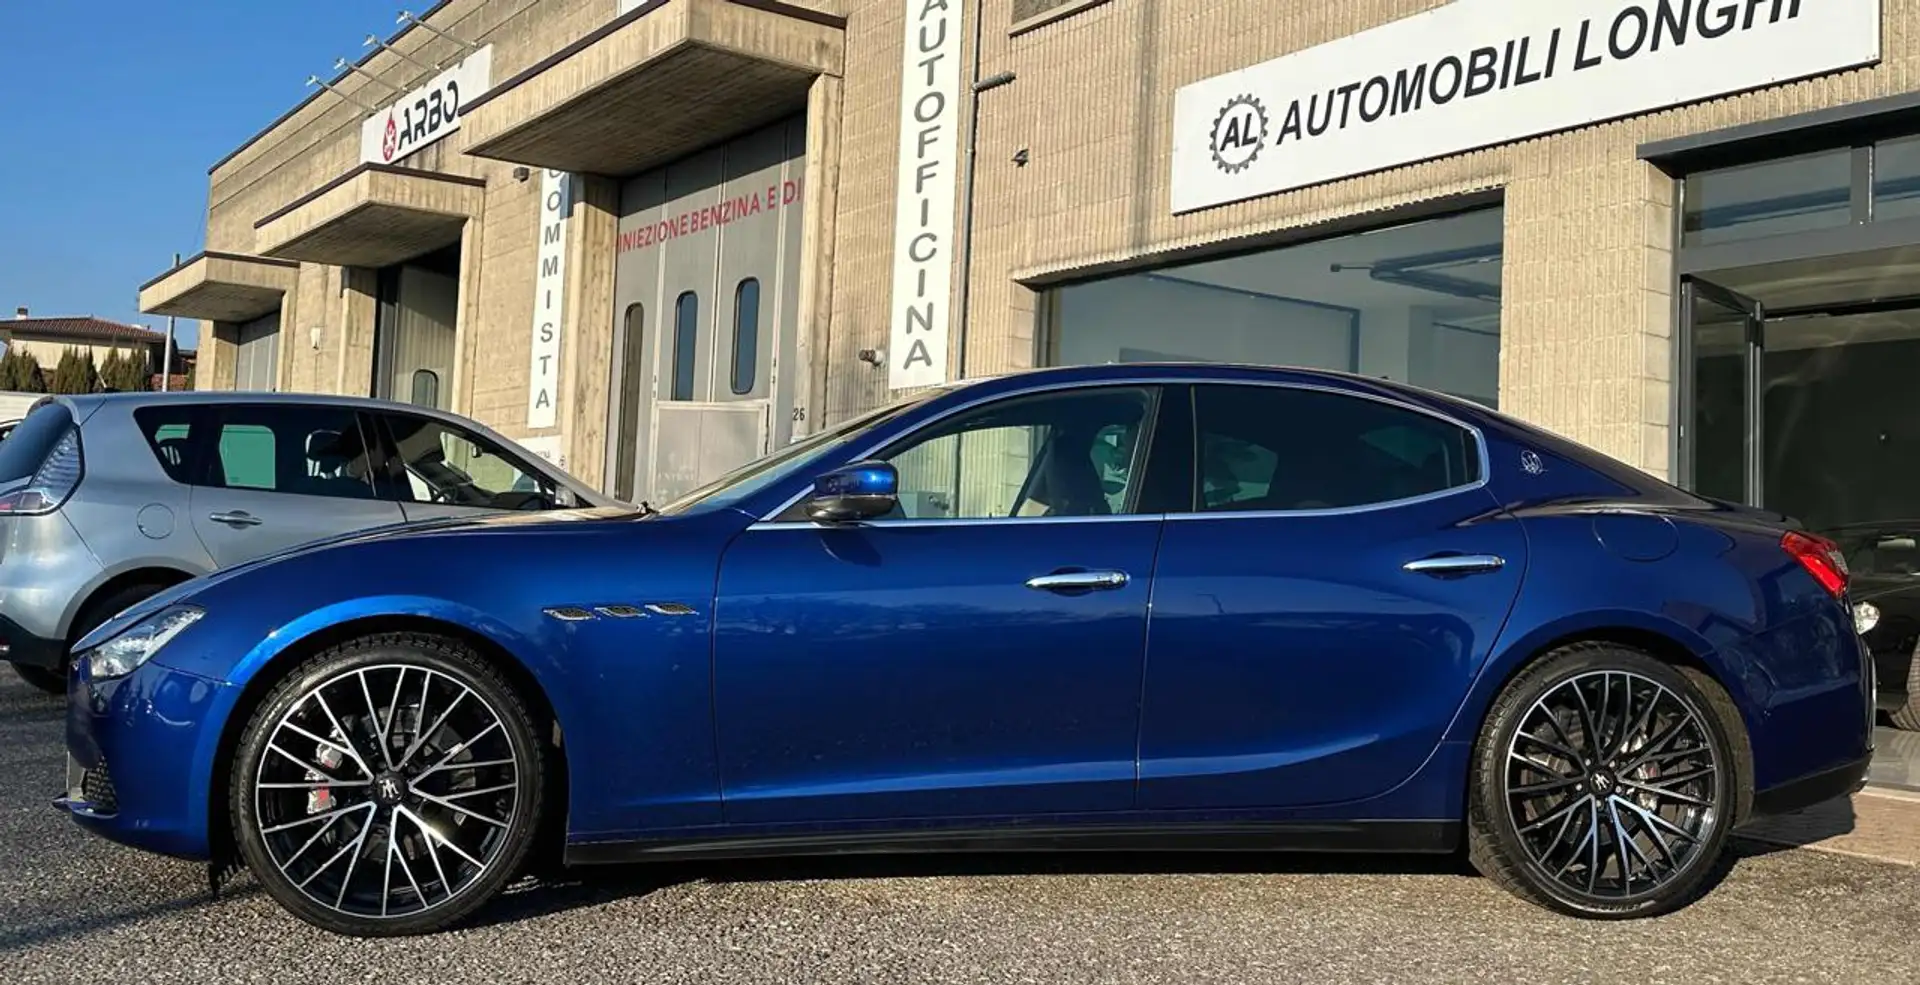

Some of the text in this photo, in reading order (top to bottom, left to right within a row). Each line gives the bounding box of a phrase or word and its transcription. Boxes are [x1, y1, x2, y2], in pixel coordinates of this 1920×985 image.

[398, 80, 459, 152] ARBO
[1219, 112, 1258, 152] AL
[1276, 29, 1561, 145] AUTOMOBILI
[619, 214, 690, 253] INIEZIONE
[690, 192, 761, 234] BENZINA
[767, 186, 777, 210] E
[904, 0, 948, 370] AUTOFFICINA
[793, 407, 805, 421] 26
